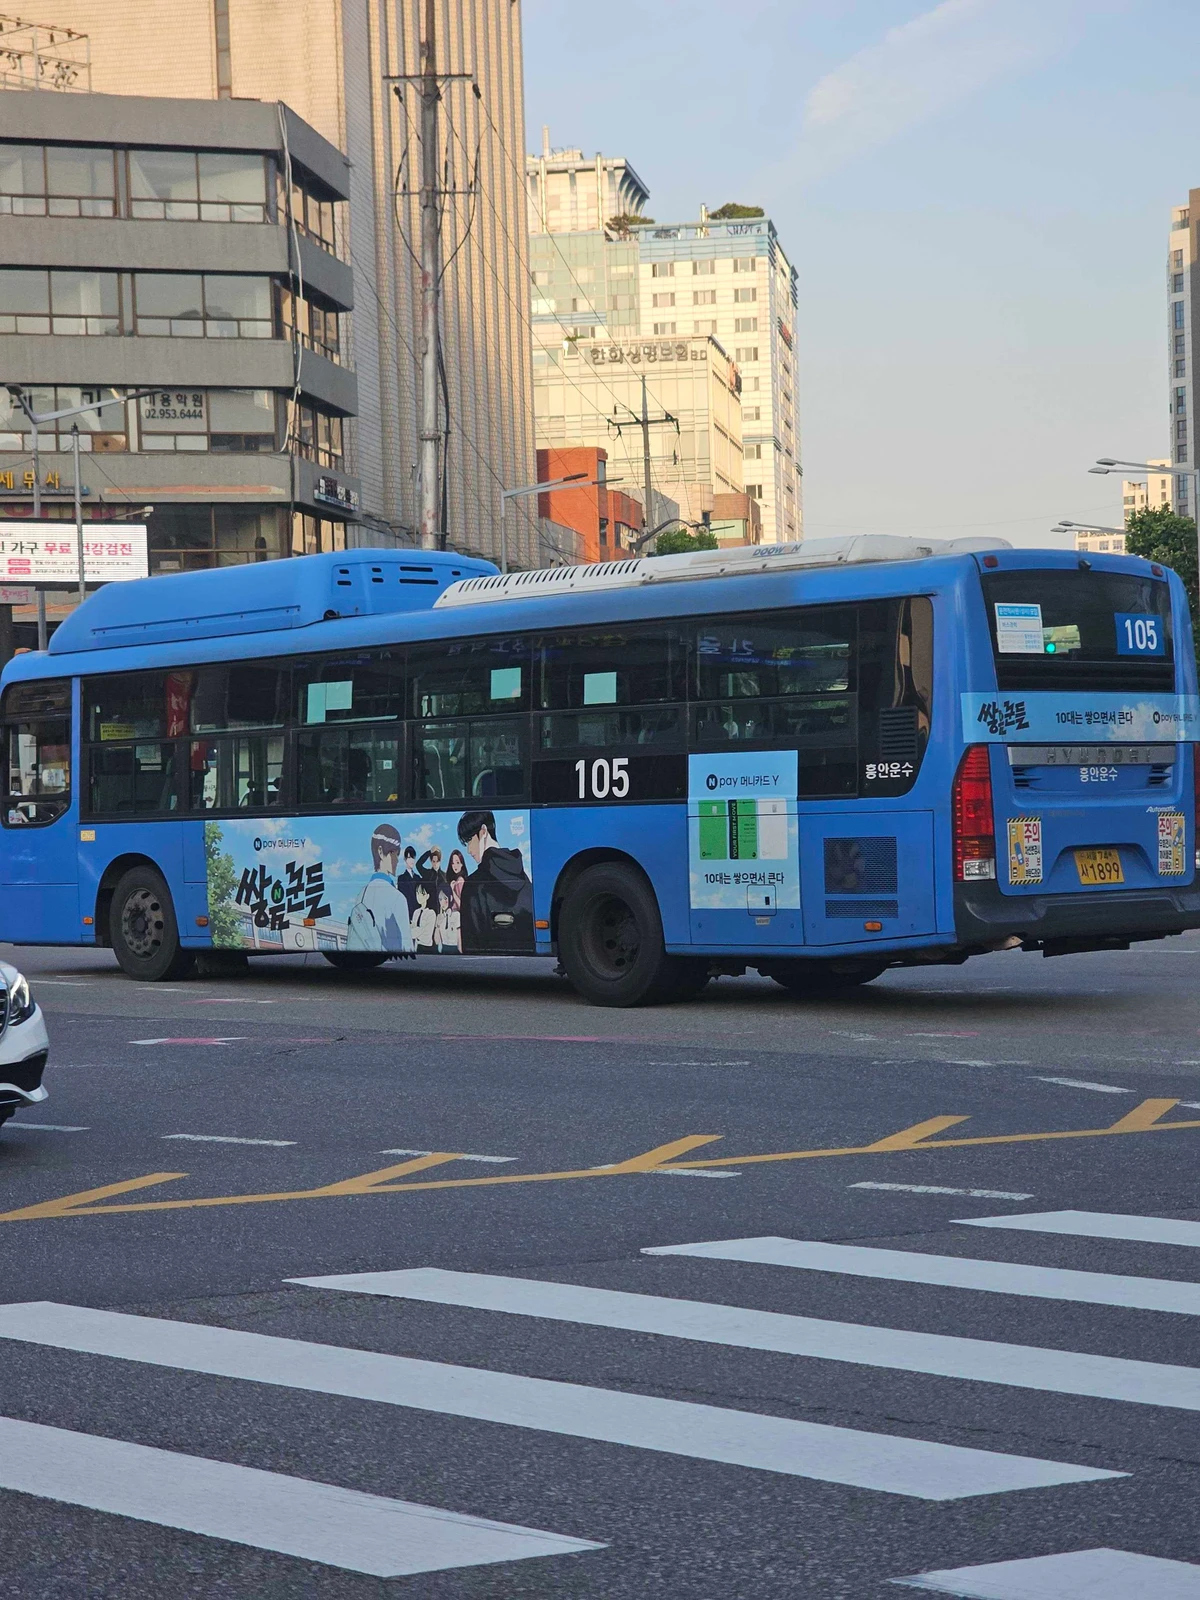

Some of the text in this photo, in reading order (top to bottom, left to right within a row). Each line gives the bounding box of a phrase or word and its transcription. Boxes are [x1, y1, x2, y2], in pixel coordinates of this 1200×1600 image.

[11, 541, 39, 554] 가구
[44, 542, 72, 555] 무료
[1124, 619, 1157, 650] 105
[1056, 711, 1133, 725] 10대는 쌓으면서 큰다
[575, 757, 630, 799] 105
[865, 762, 914, 780] 흥안운수
[1080, 767, 1118, 782] 흥안운수
[740, 775, 771, 787] 머니카드
[772, 775, 779, 786] Y
[1024, 823, 1040, 843] 주의
[1159, 818, 1172, 836] 주의
[704, 872, 785, 885] 10대는 쌓으면서 큰다
